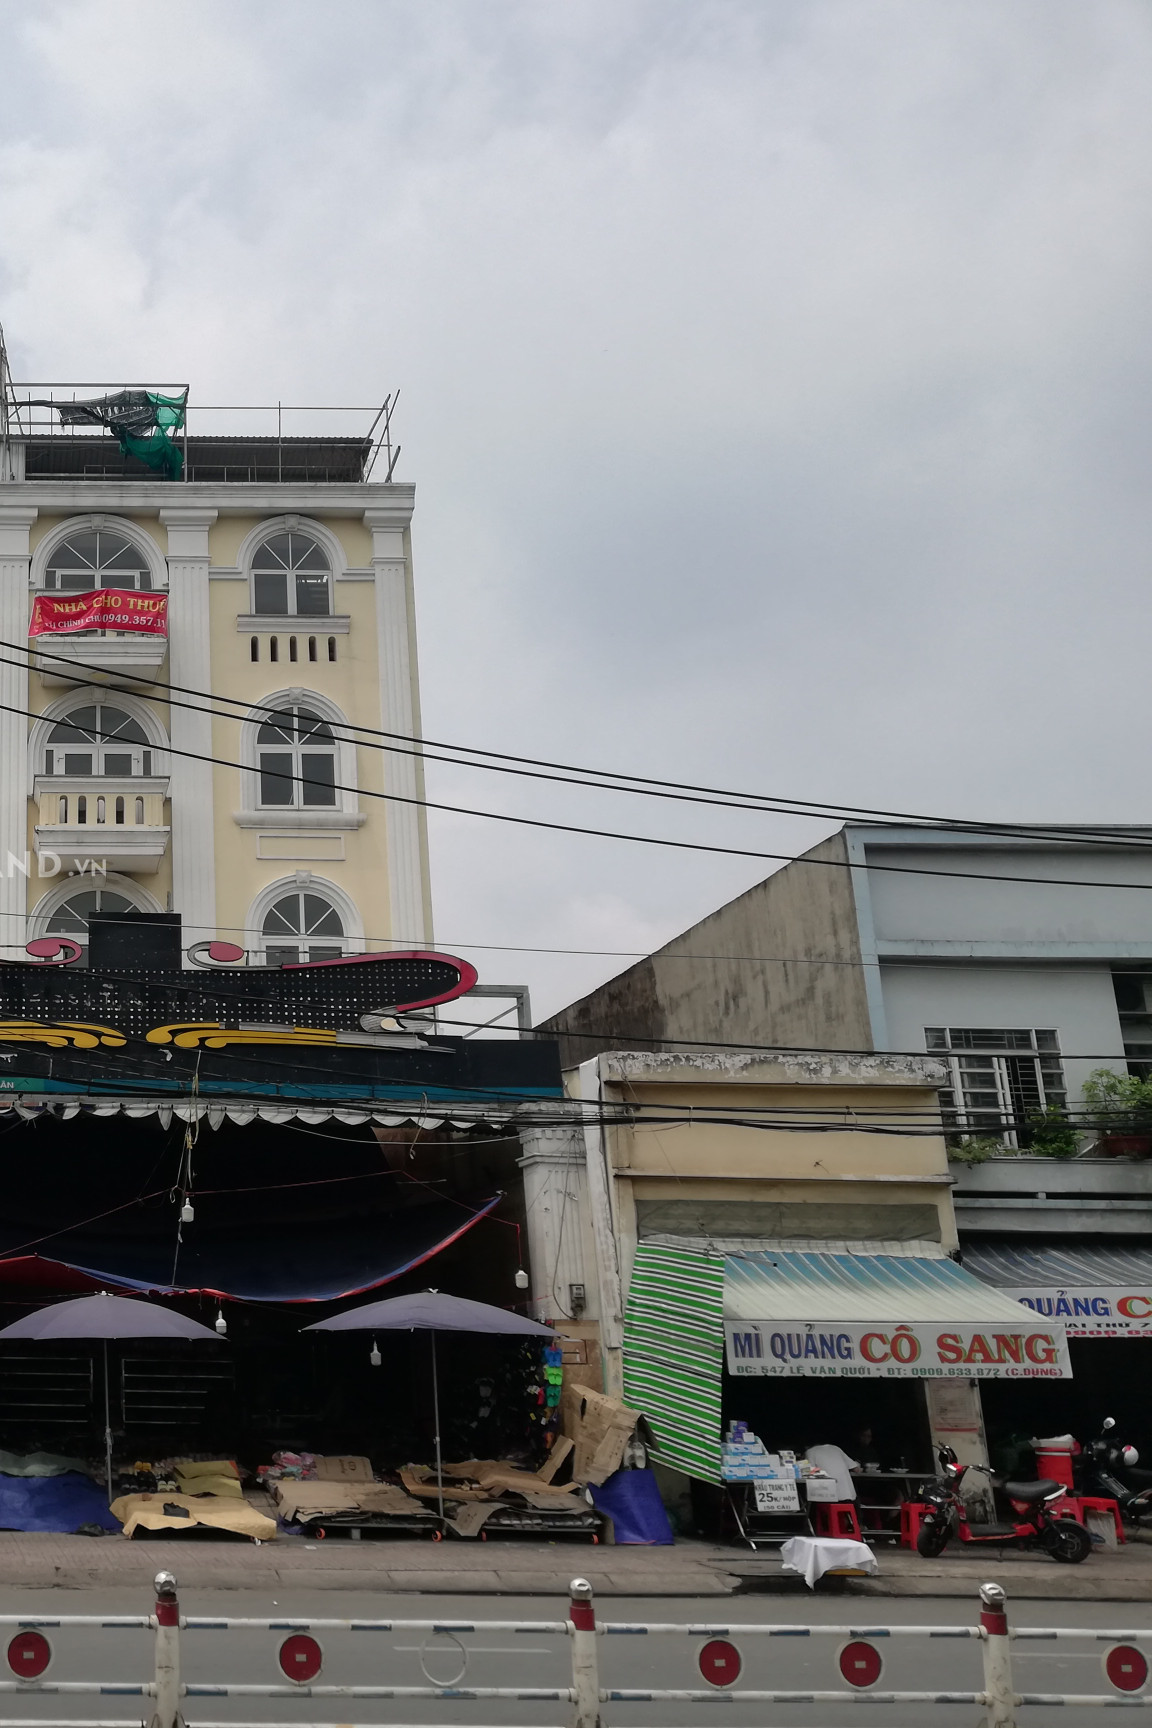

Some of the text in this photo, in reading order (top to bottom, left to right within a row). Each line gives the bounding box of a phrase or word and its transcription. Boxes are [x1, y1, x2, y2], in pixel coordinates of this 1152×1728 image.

[53, 598, 87, 614] NHÀ
[93, 595, 121, 608] CHO
[732, 1324, 1059, 1364] MÌ QUẢNG CÔ SANG
[761, 1366, 785, 1374] 547
